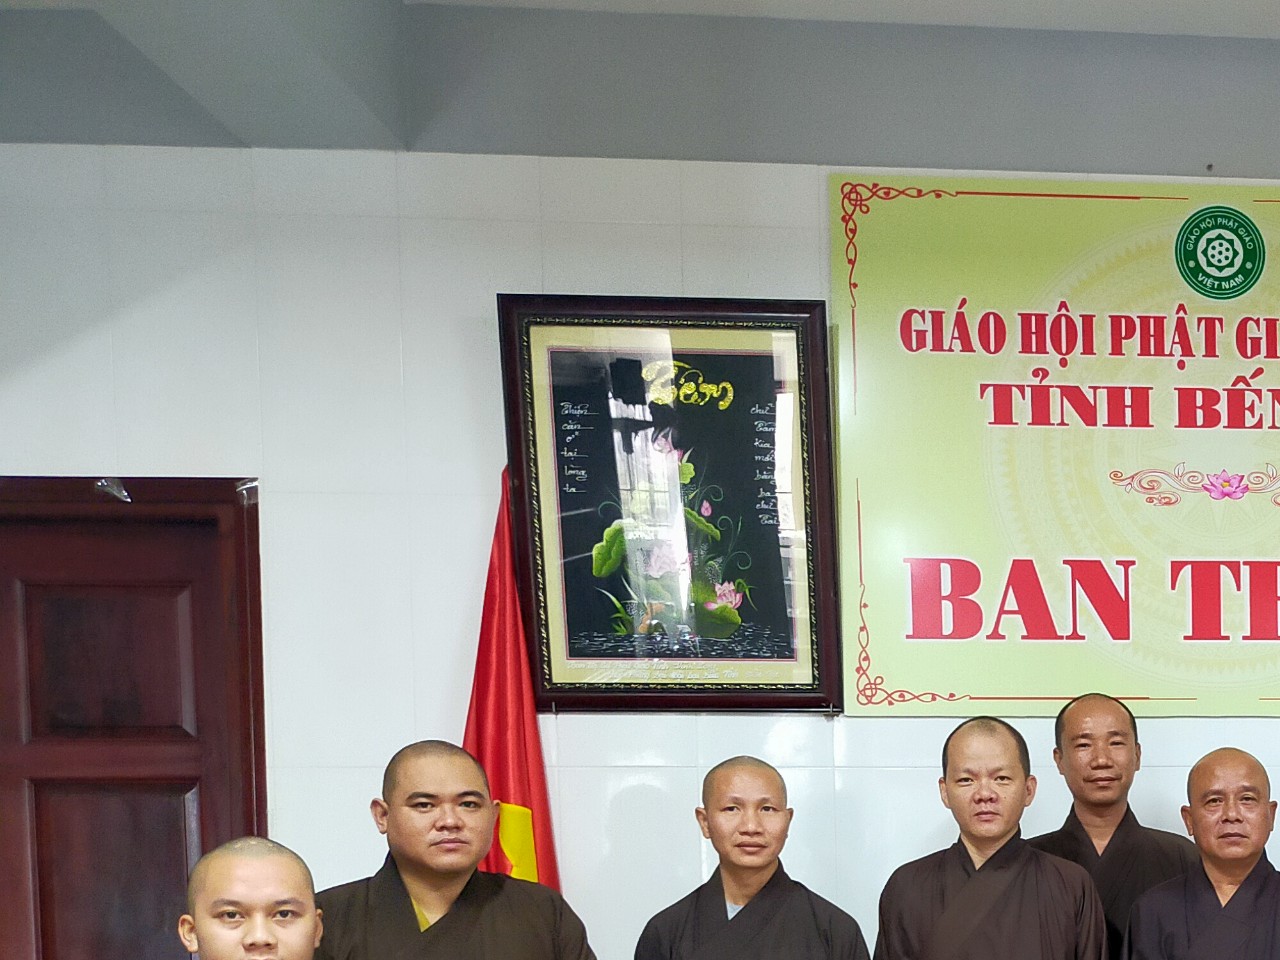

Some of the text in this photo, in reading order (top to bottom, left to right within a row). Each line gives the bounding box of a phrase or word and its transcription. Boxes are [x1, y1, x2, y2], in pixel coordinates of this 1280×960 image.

[1186, 218, 1253, 250] GIÁO HỘI PHẬT GIÁO
[1198, 273, 1244, 289] VIỆT NAM
[900, 297, 1006, 354] GIÁO
[1017, 300, 1096, 368] HỘI
[1108, 303, 1224, 370] PHẬT
[980, 367, 1154, 428] TỈNH
[561, 447, 588, 460] tại
[564, 464, 588, 481] lòng
[563, 483, 587, 493] ta
[903, 557, 1136, 641] BAN
